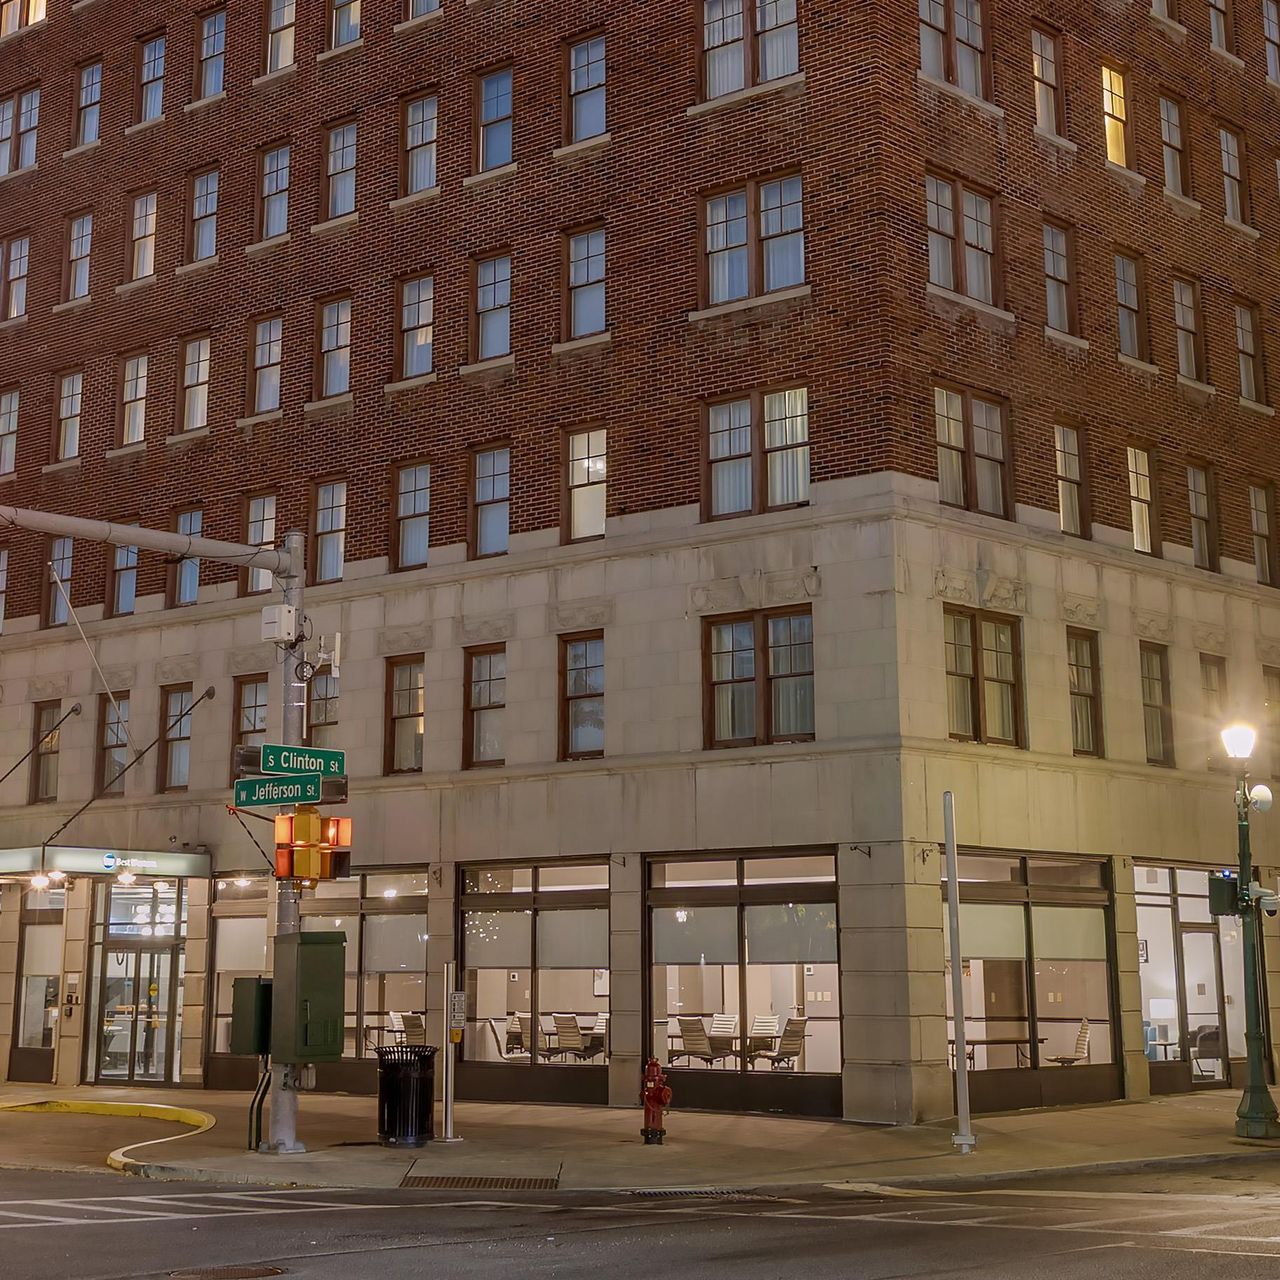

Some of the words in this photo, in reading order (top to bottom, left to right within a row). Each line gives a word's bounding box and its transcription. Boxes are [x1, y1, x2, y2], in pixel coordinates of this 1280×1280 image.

[268, 755, 275, 767] S
[281, 751, 324, 771] Clinton
[329, 760, 340, 773] St
[240, 790, 247, 801] W
[252, 783, 301, 800] Jefferson
[306, 784, 315, 796] St
